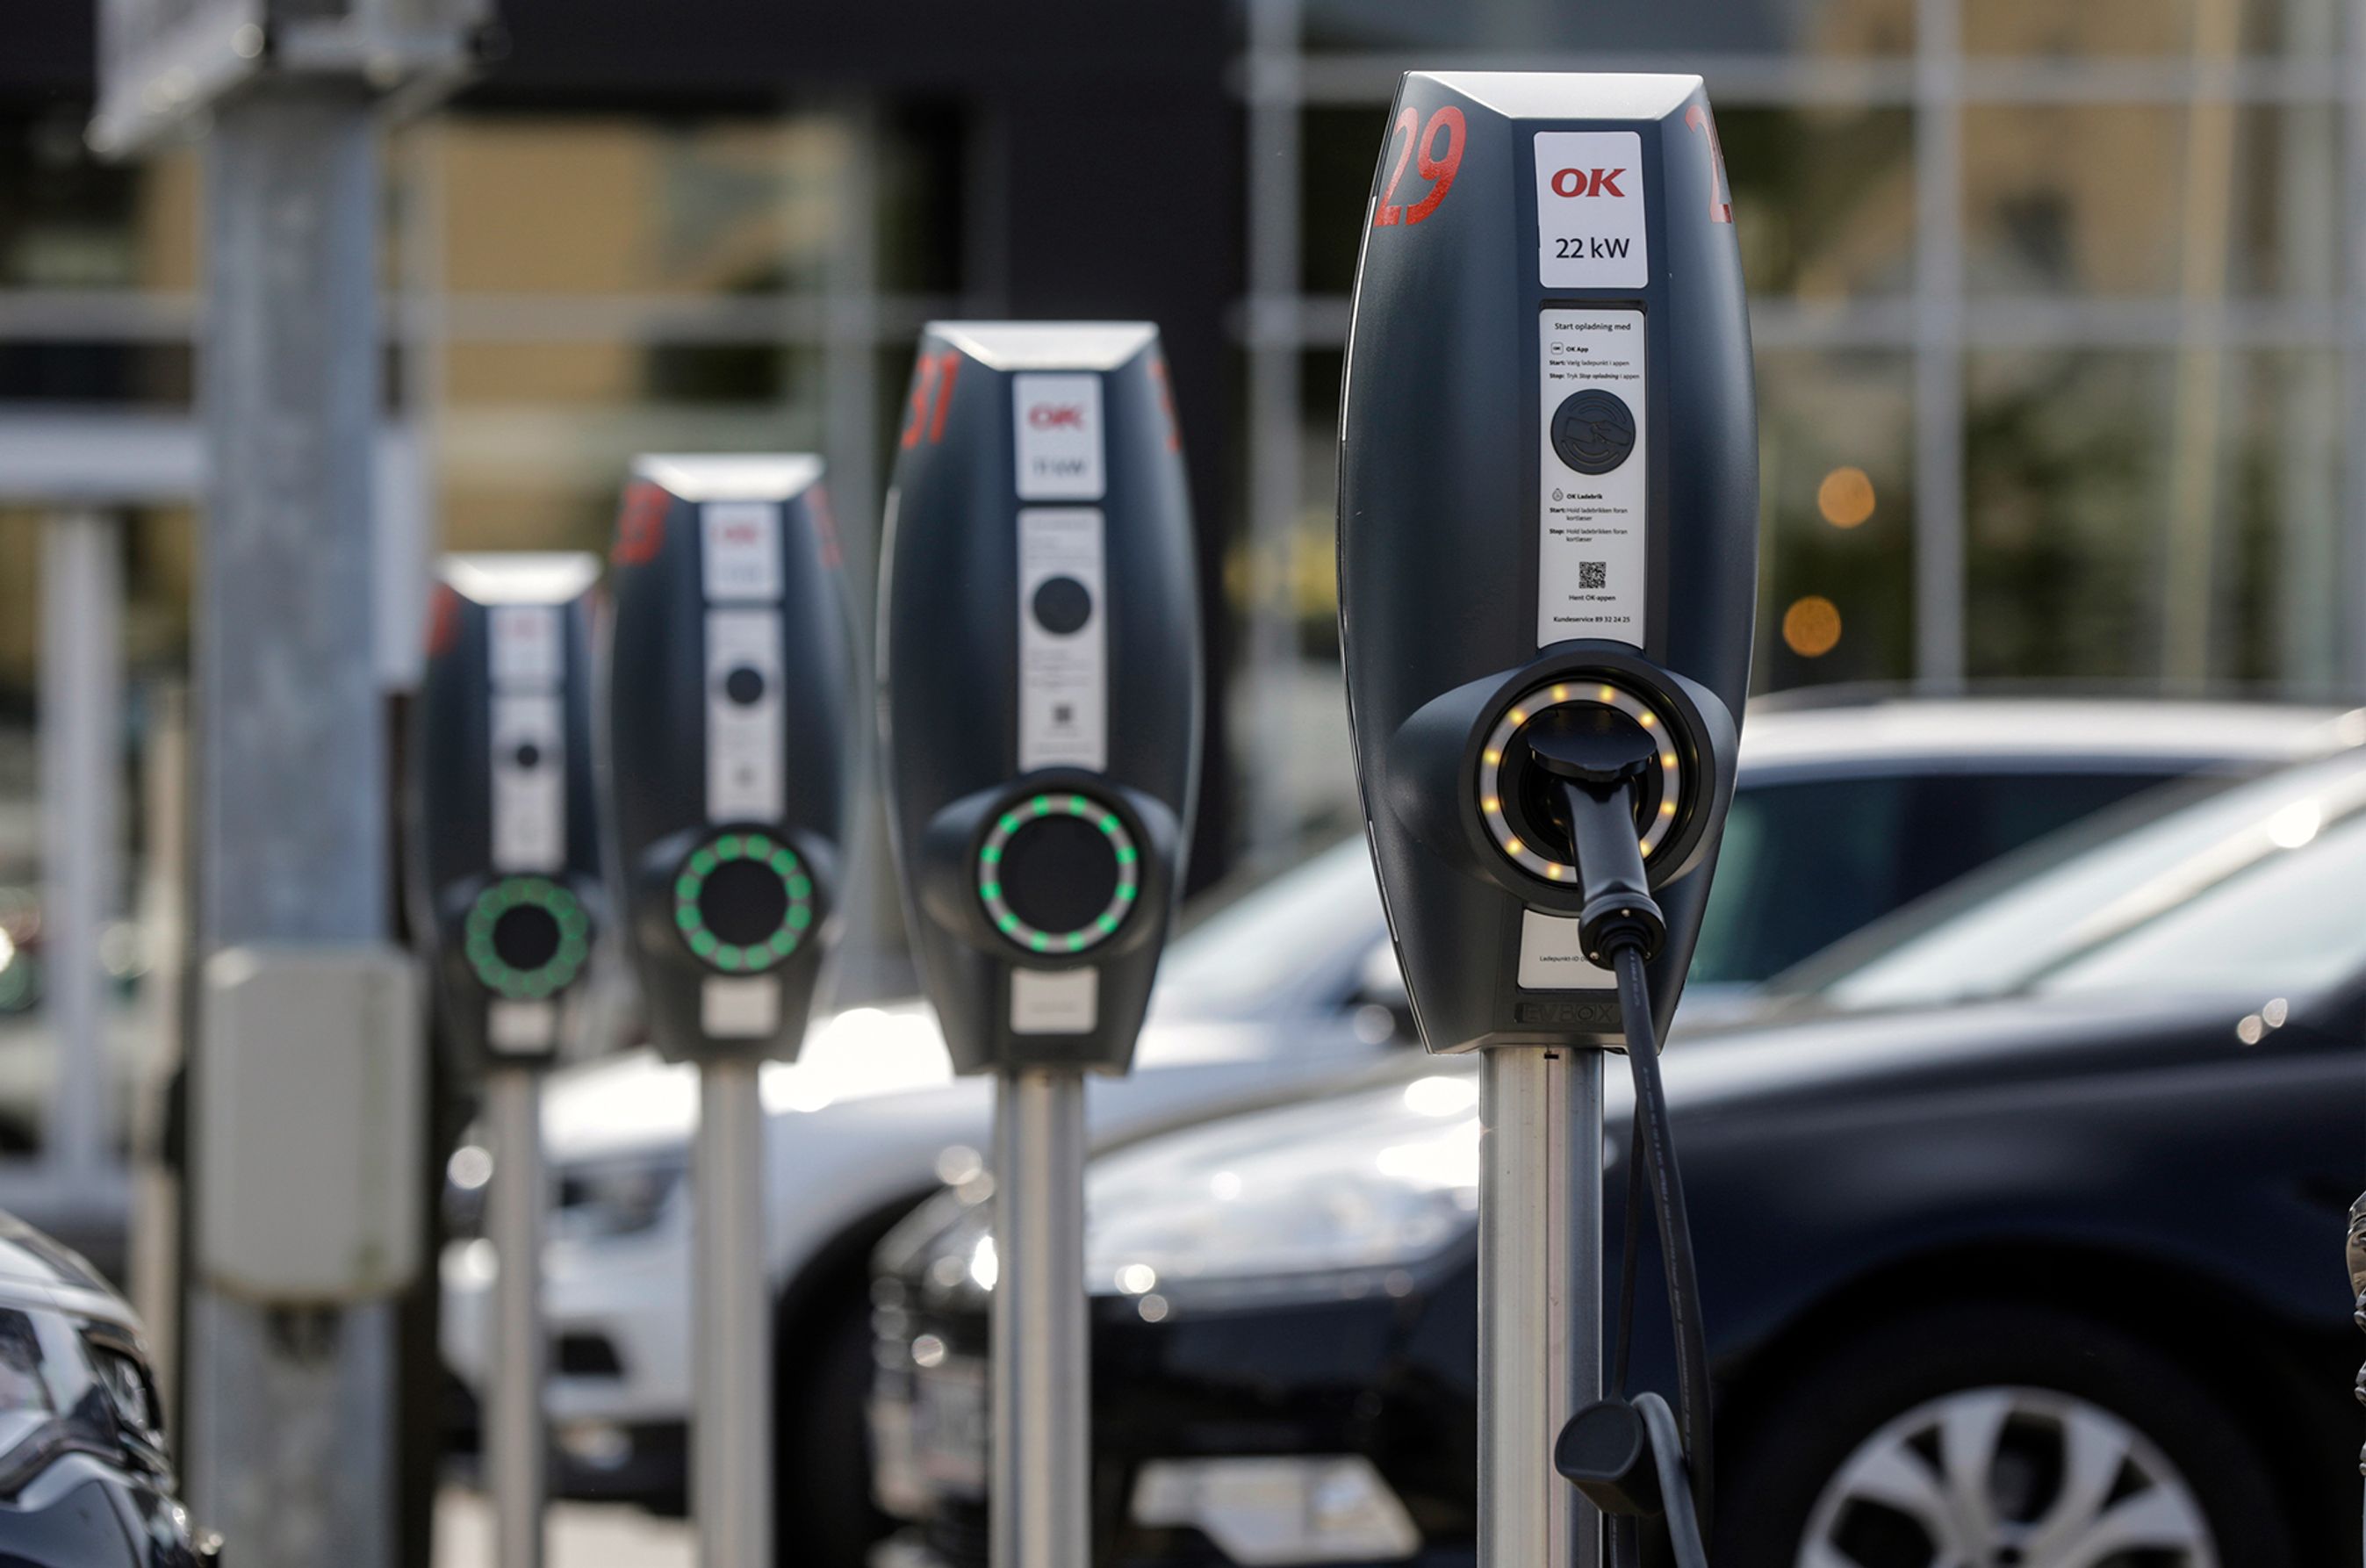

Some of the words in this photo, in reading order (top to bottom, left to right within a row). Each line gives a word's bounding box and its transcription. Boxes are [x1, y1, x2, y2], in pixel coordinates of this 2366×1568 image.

[1373, 105, 1467, 227] 29
[1550, 168, 1627, 198] OK
[1555, 238, 1585, 259] 22
[1591, 237, 1630, 259] kW
[1575, 322, 1613, 332] opladning
[1028, 404, 1085, 430] OK
